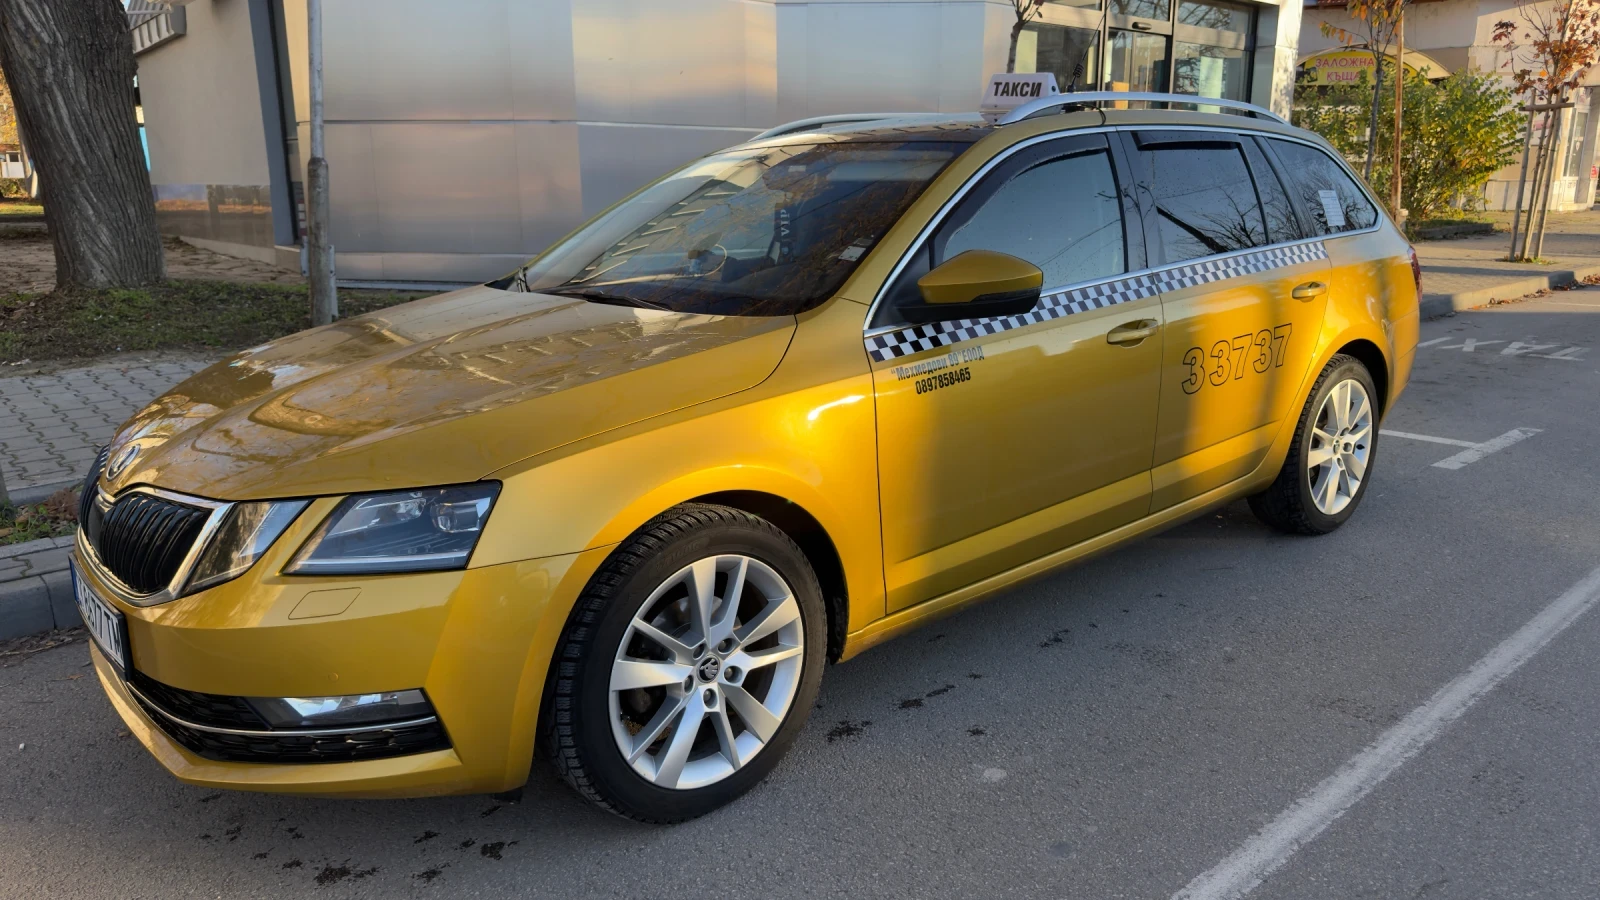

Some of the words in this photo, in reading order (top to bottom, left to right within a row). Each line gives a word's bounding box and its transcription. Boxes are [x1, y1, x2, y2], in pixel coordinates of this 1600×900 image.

[1315, 57, 1375, 68] ЗАЛОЖНА
[993, 82, 1042, 97] ТАКСИ
[1181, 322, 1292, 395] 33737
[915, 368, 970, 395] 0897858465
